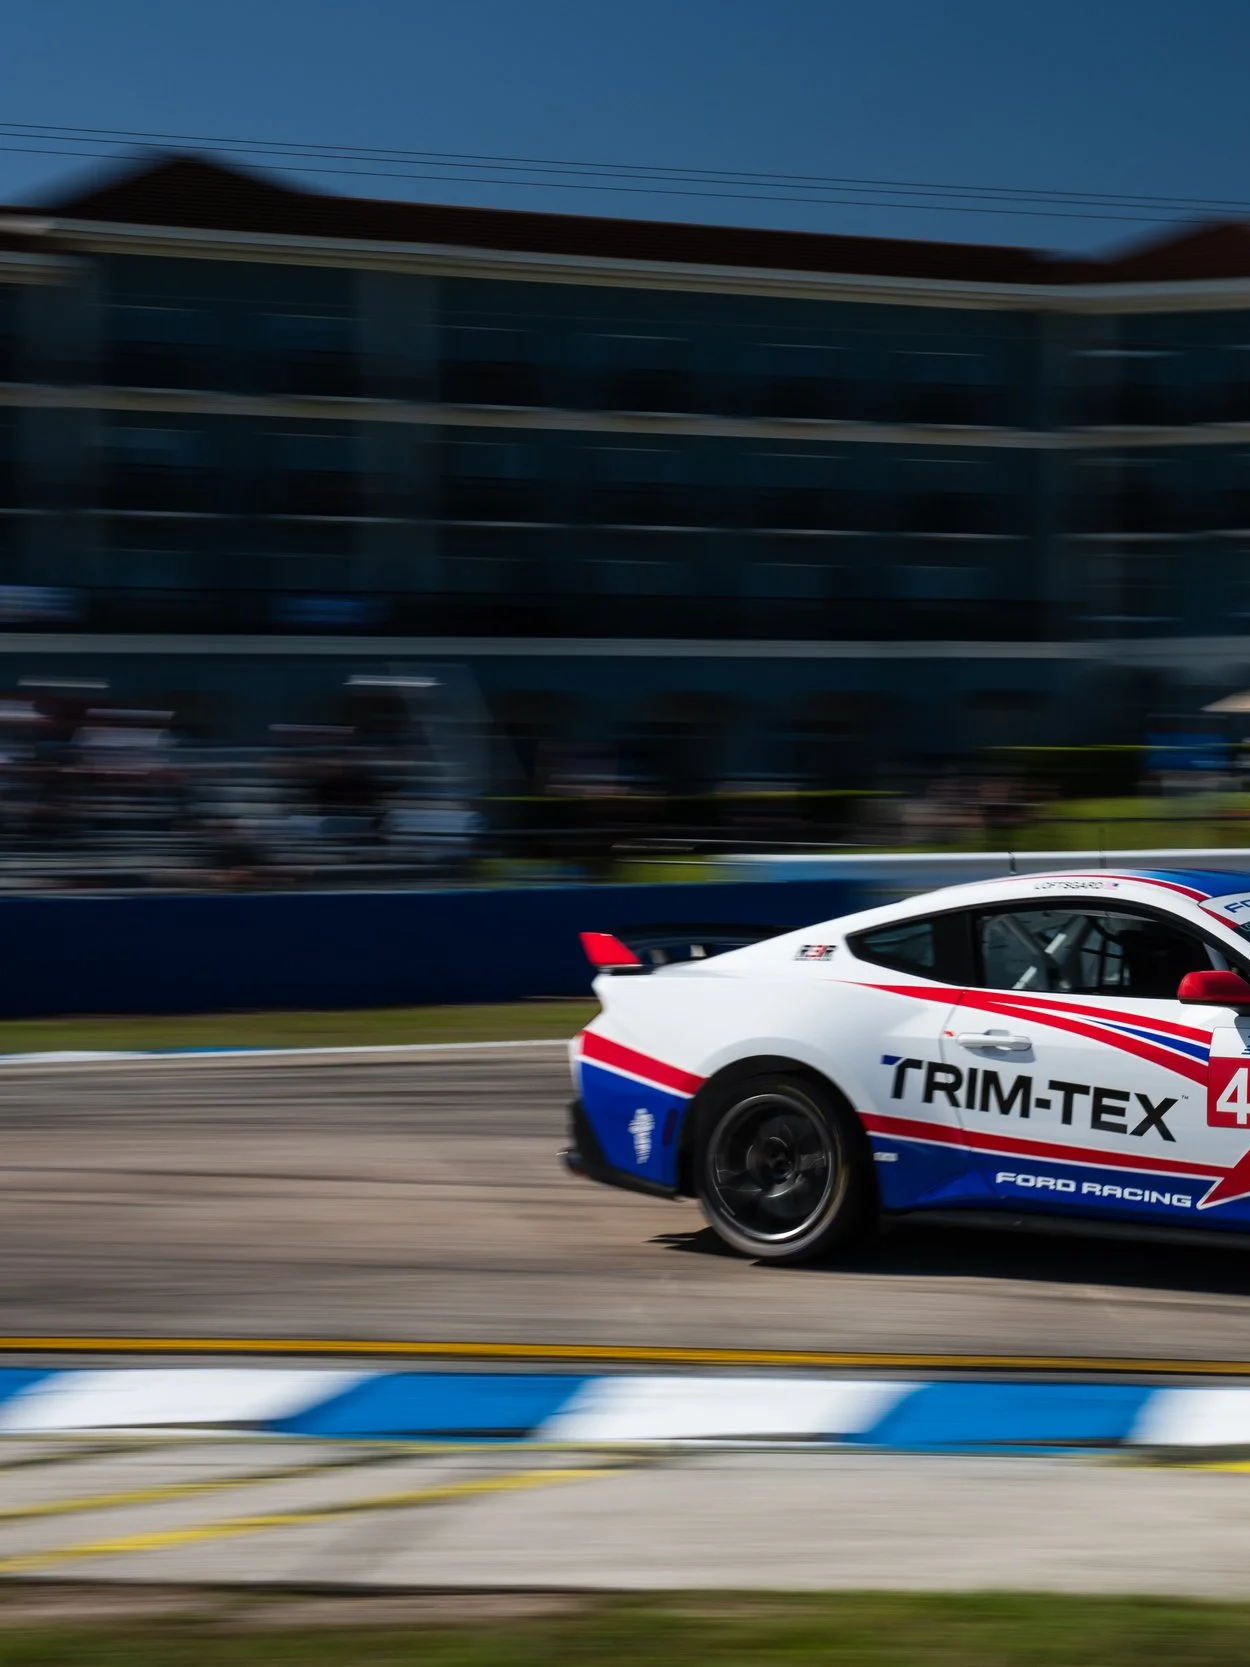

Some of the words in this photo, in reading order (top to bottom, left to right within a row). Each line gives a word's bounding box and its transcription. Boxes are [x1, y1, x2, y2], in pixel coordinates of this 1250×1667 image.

[880, 1054, 1179, 1143] TRIM-TEX
[995, 1171, 1076, 1193] FORD
[1081, 1181, 1192, 1208] RACING
